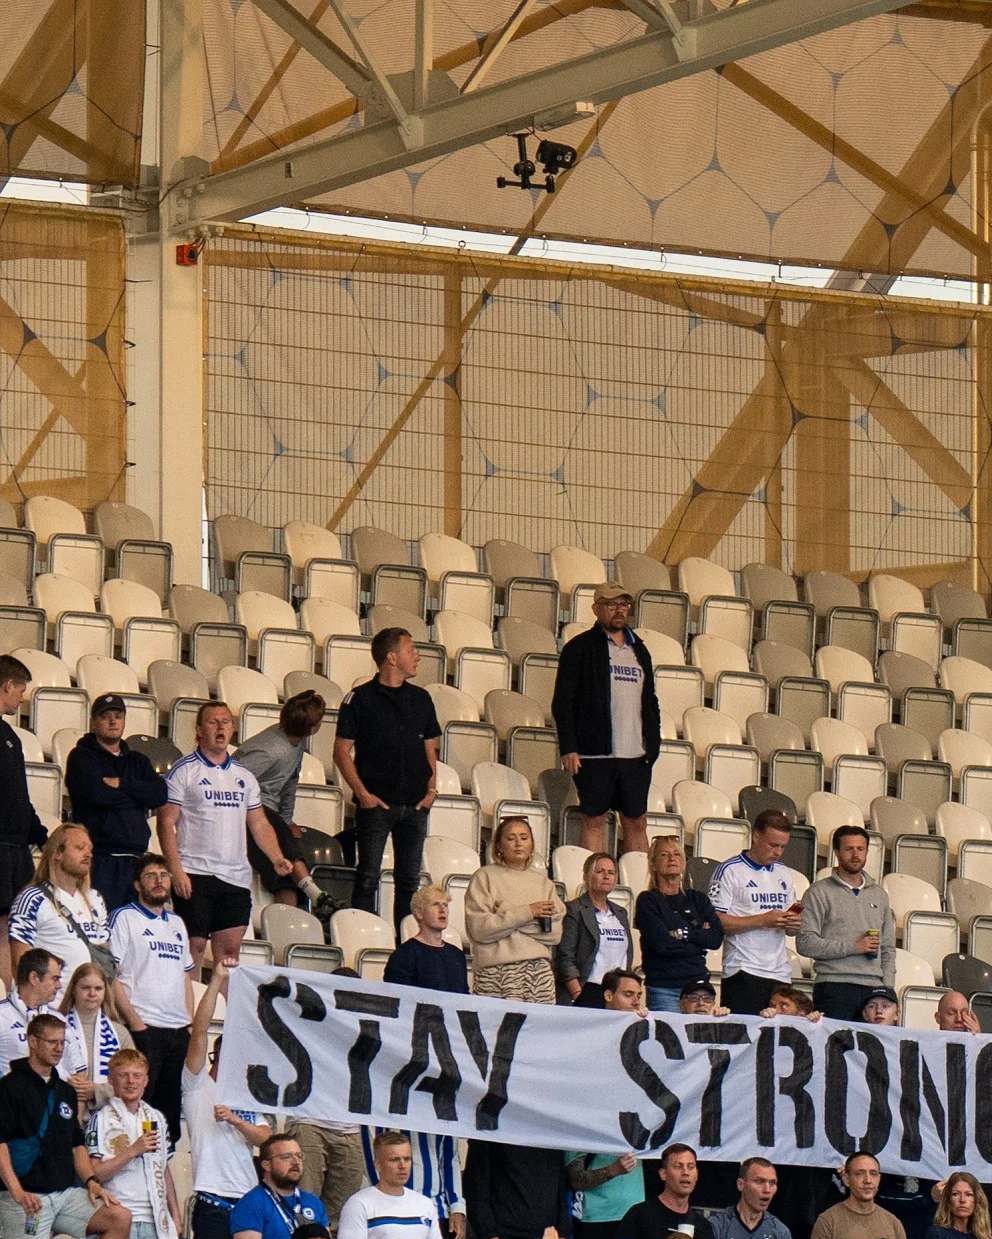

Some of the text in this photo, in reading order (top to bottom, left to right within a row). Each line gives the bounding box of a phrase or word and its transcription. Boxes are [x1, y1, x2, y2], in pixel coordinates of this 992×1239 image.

[205, 790, 245, 802] UNIBET
[751, 892, 788, 904] UNIBET
[149, 941, 184, 955] UNIBET
[247, 975, 527, 1130] STAY
